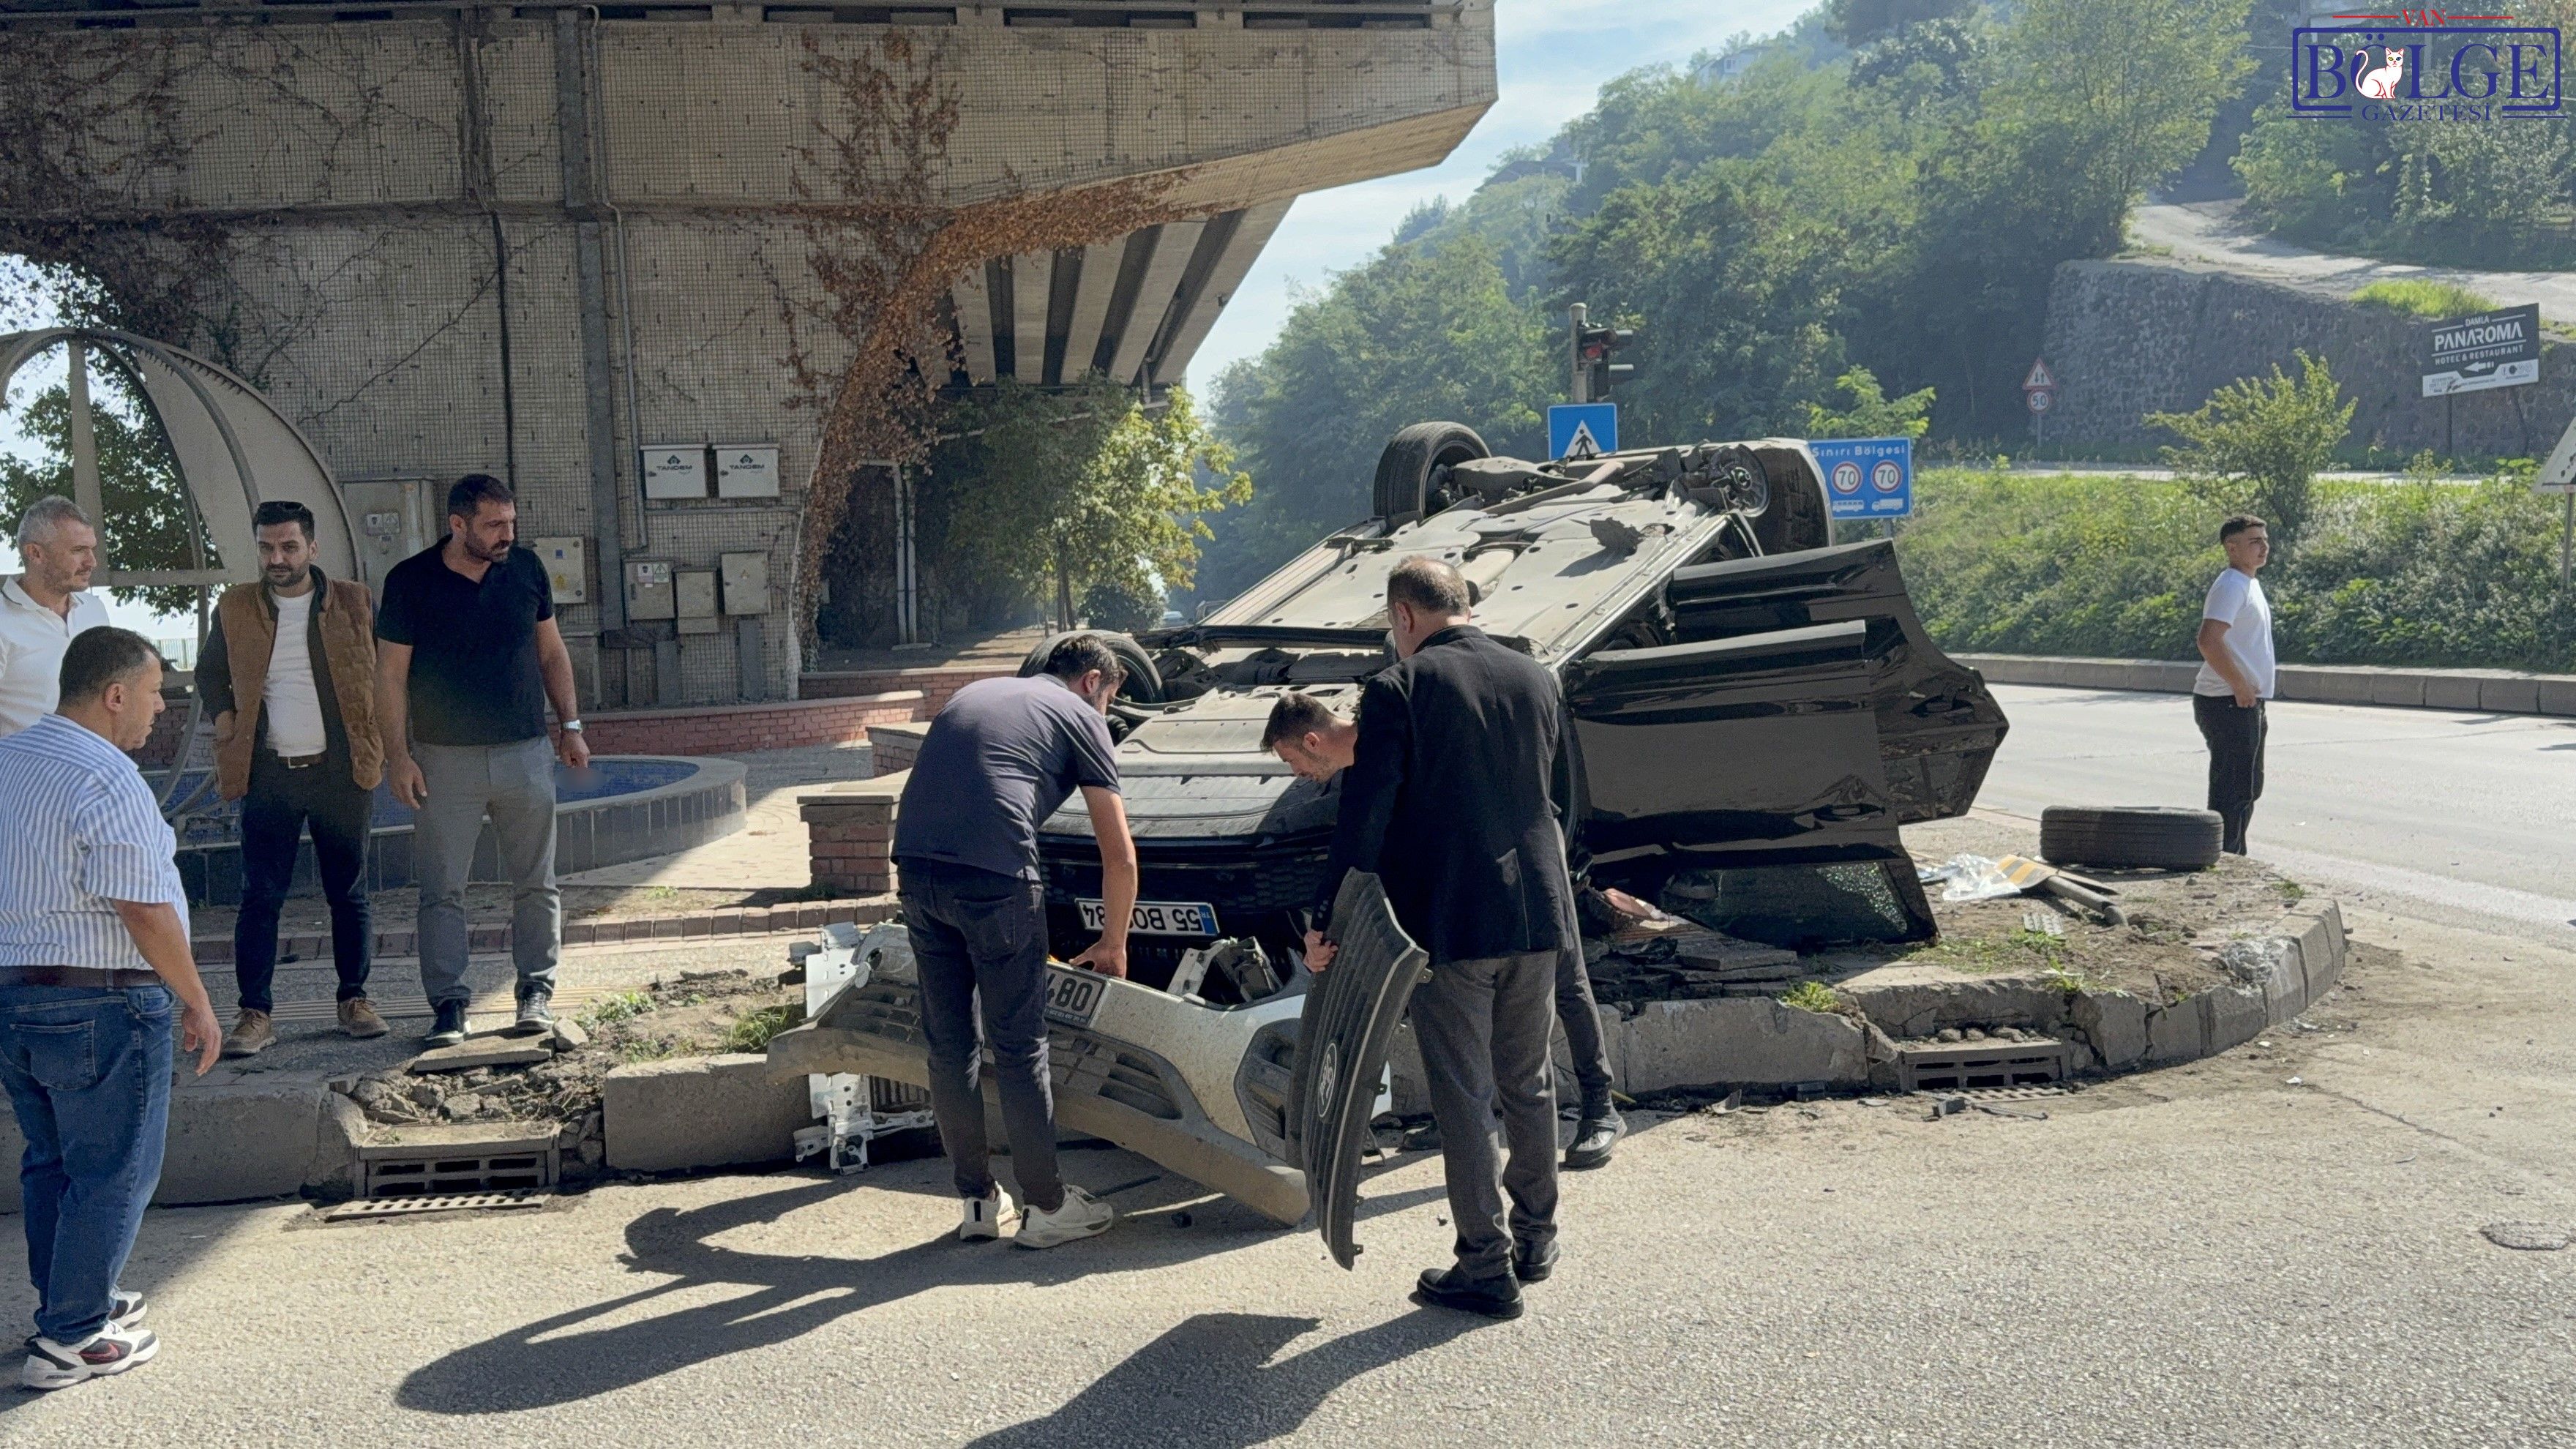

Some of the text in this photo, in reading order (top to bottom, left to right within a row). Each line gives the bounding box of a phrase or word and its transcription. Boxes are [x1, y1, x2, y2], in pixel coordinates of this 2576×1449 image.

[2435, 321, 2523, 351] PANAROMA
[2435, 354, 2460, 366] HOTEL
[2469, 344, 2523, 360] RESTAURANT
[2032, 395, 2047, 406] 50
[1812, 445, 1905, 457] Sınırı Bölgesi
[1838, 470, 1857, 486] 70
[1878, 469, 1896, 484] 70
[1172, 909, 1204, 932] 55
